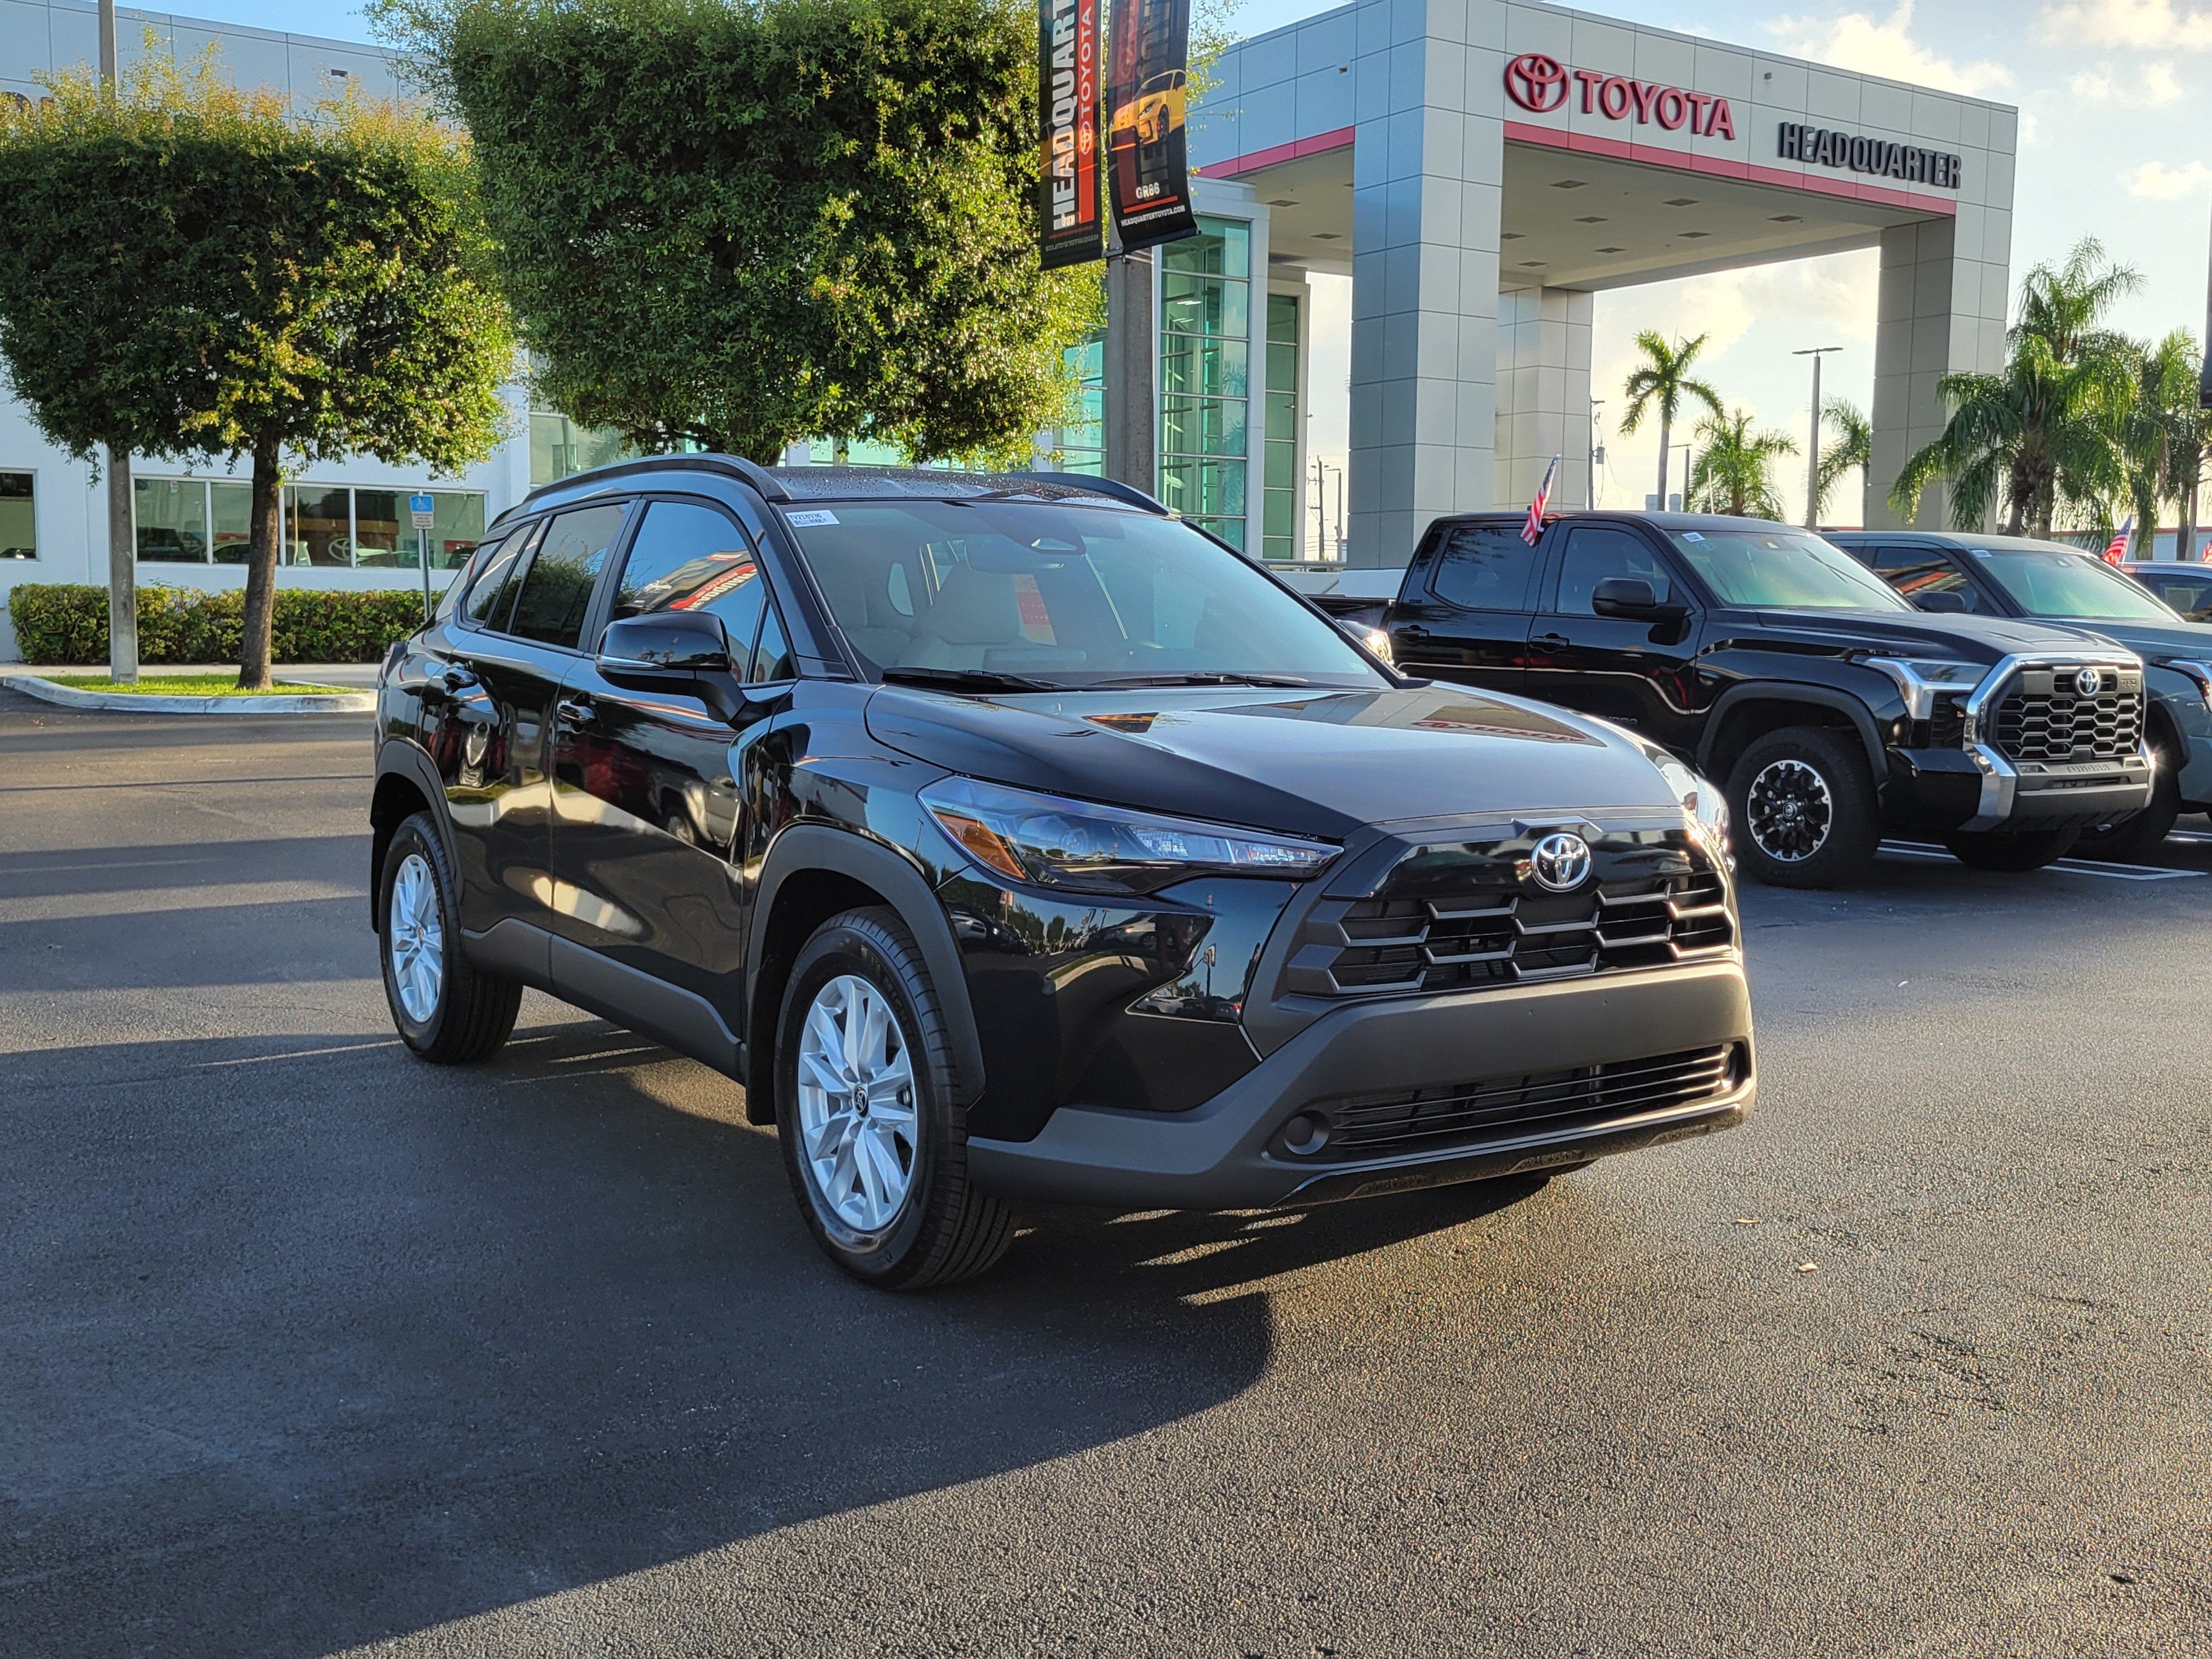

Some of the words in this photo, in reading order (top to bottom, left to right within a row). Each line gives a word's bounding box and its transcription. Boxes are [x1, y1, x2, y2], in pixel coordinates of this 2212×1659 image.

[1081, 5, 1092, 113] TOYOTA
[1575, 70, 1736, 140] TOYOTA
[1777, 121, 1962, 189] HEADQUARTER
[1120, 205, 1186, 227] HEADQUARTERTOYOTA.COM
[1136, 182, 1160, 199] GR86
